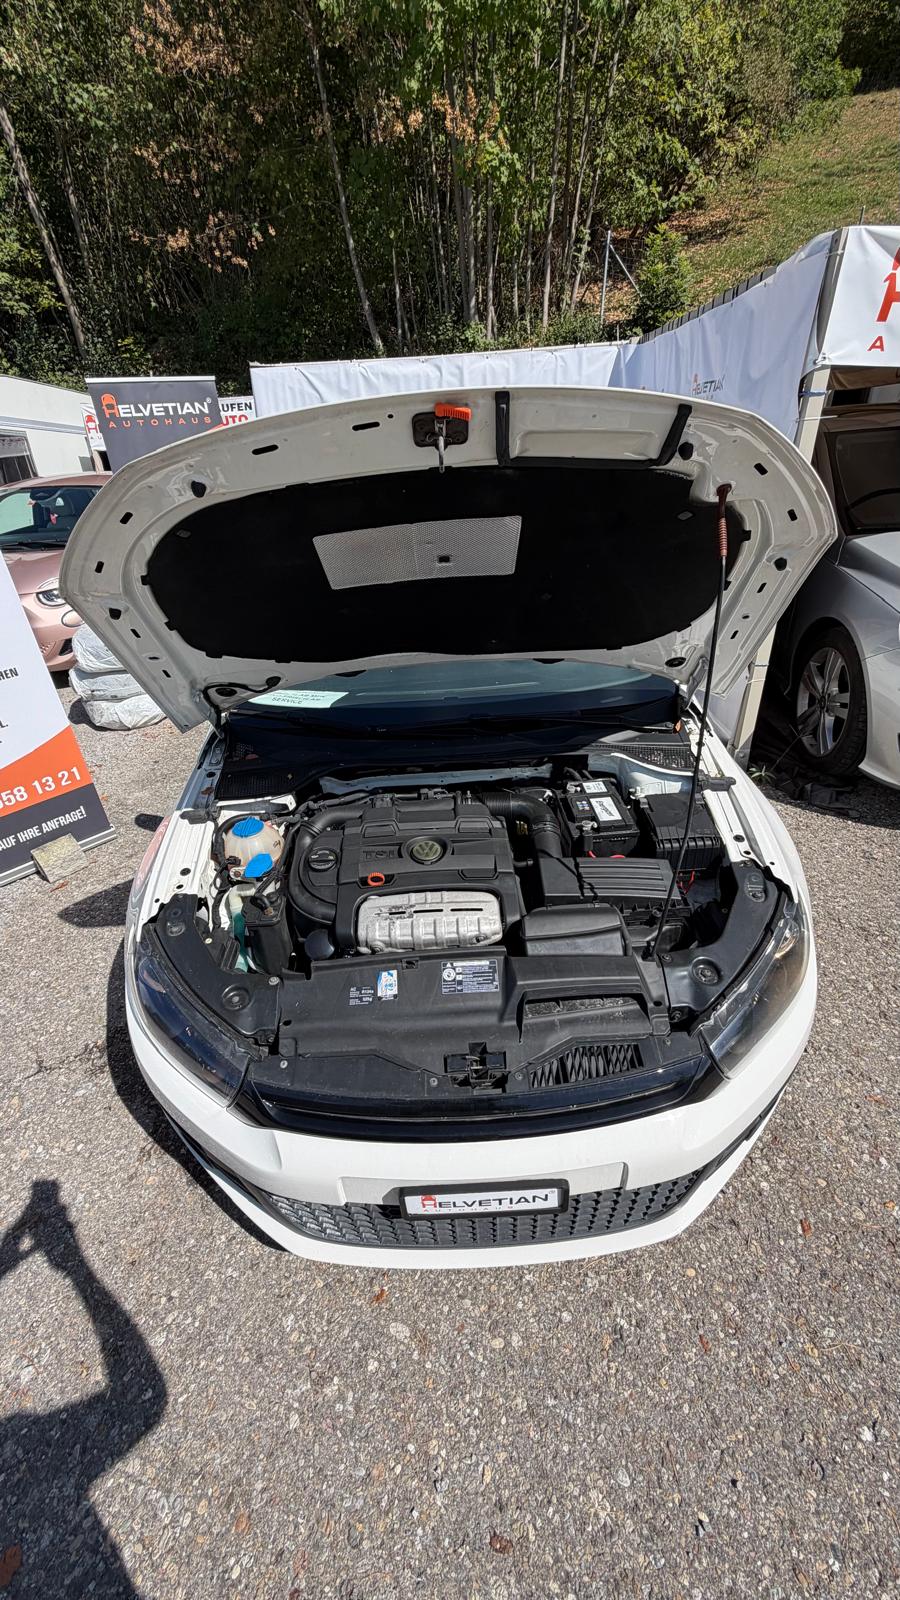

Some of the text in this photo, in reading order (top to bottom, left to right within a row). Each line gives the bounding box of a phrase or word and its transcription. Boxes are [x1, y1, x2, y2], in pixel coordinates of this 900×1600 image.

[108, 417, 212, 428] AUTOHAUS
[0, 767, 80, 809] 58 13 21
[0, 806, 86, 851] AUF IHRE ANFRAGE!
[362, 850, 395, 859] TSI
